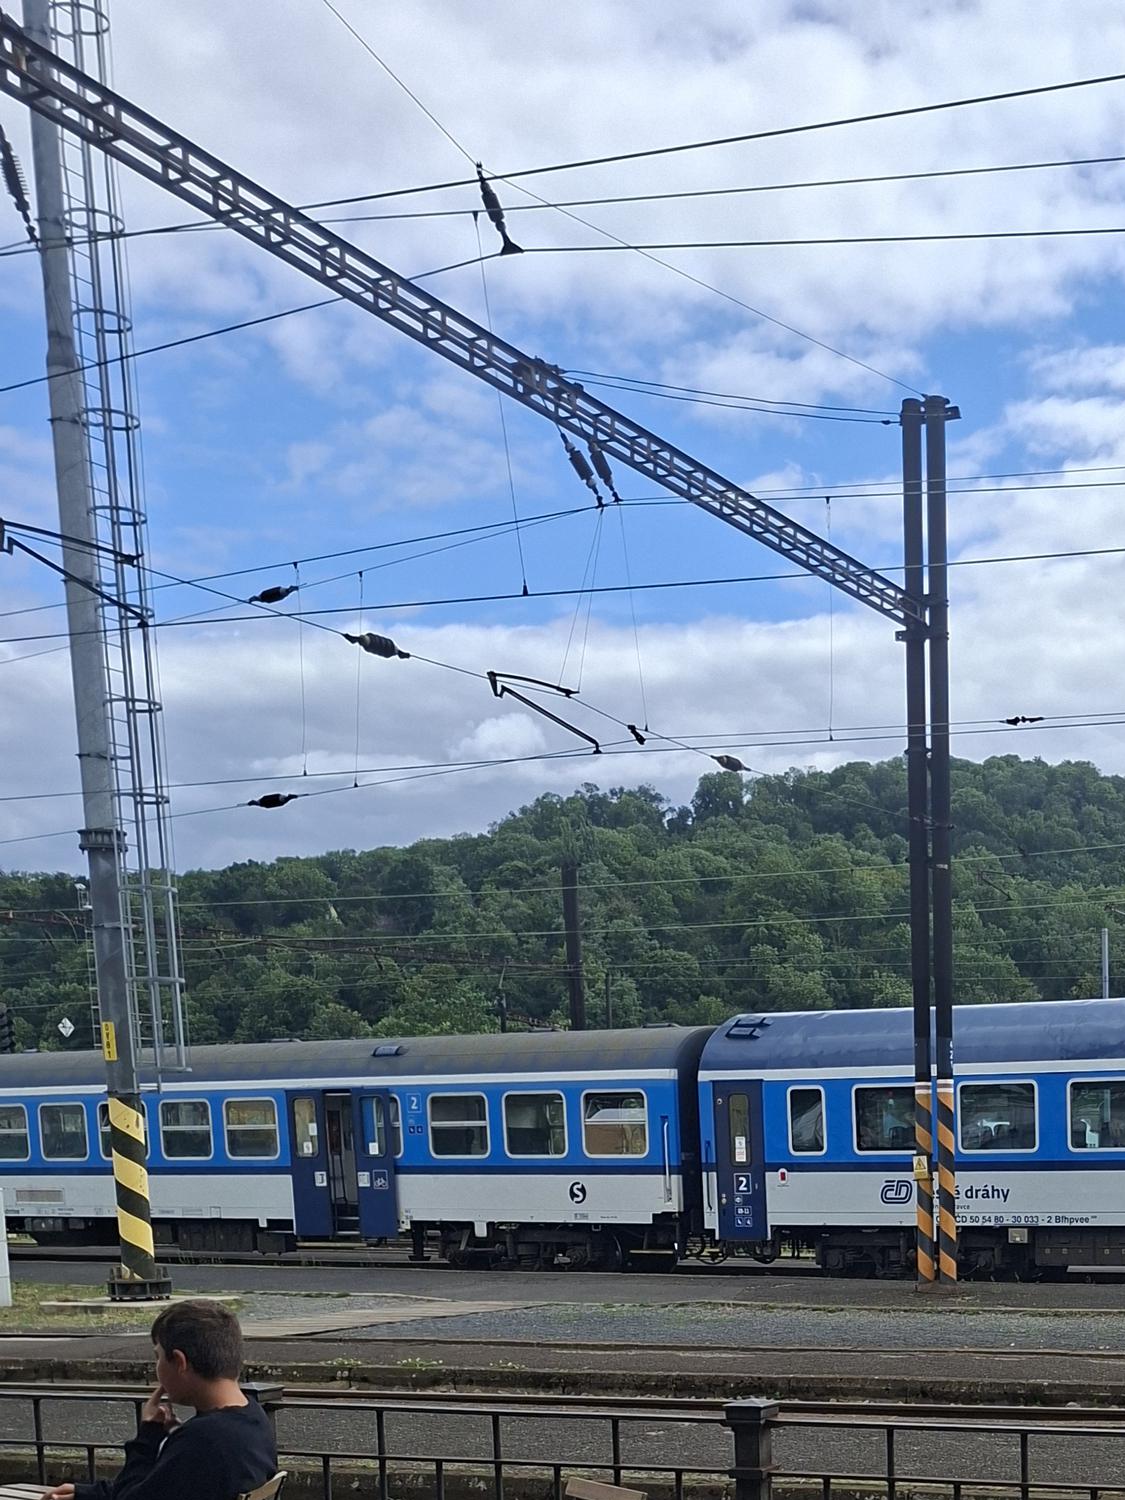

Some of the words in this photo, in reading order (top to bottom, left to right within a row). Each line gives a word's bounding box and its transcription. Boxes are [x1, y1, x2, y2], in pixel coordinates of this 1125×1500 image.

[411, 1096, 418, 1110] 2
[738, 1176, 748, 1191] 2
[964, 1185, 1010, 1202] dráhy
